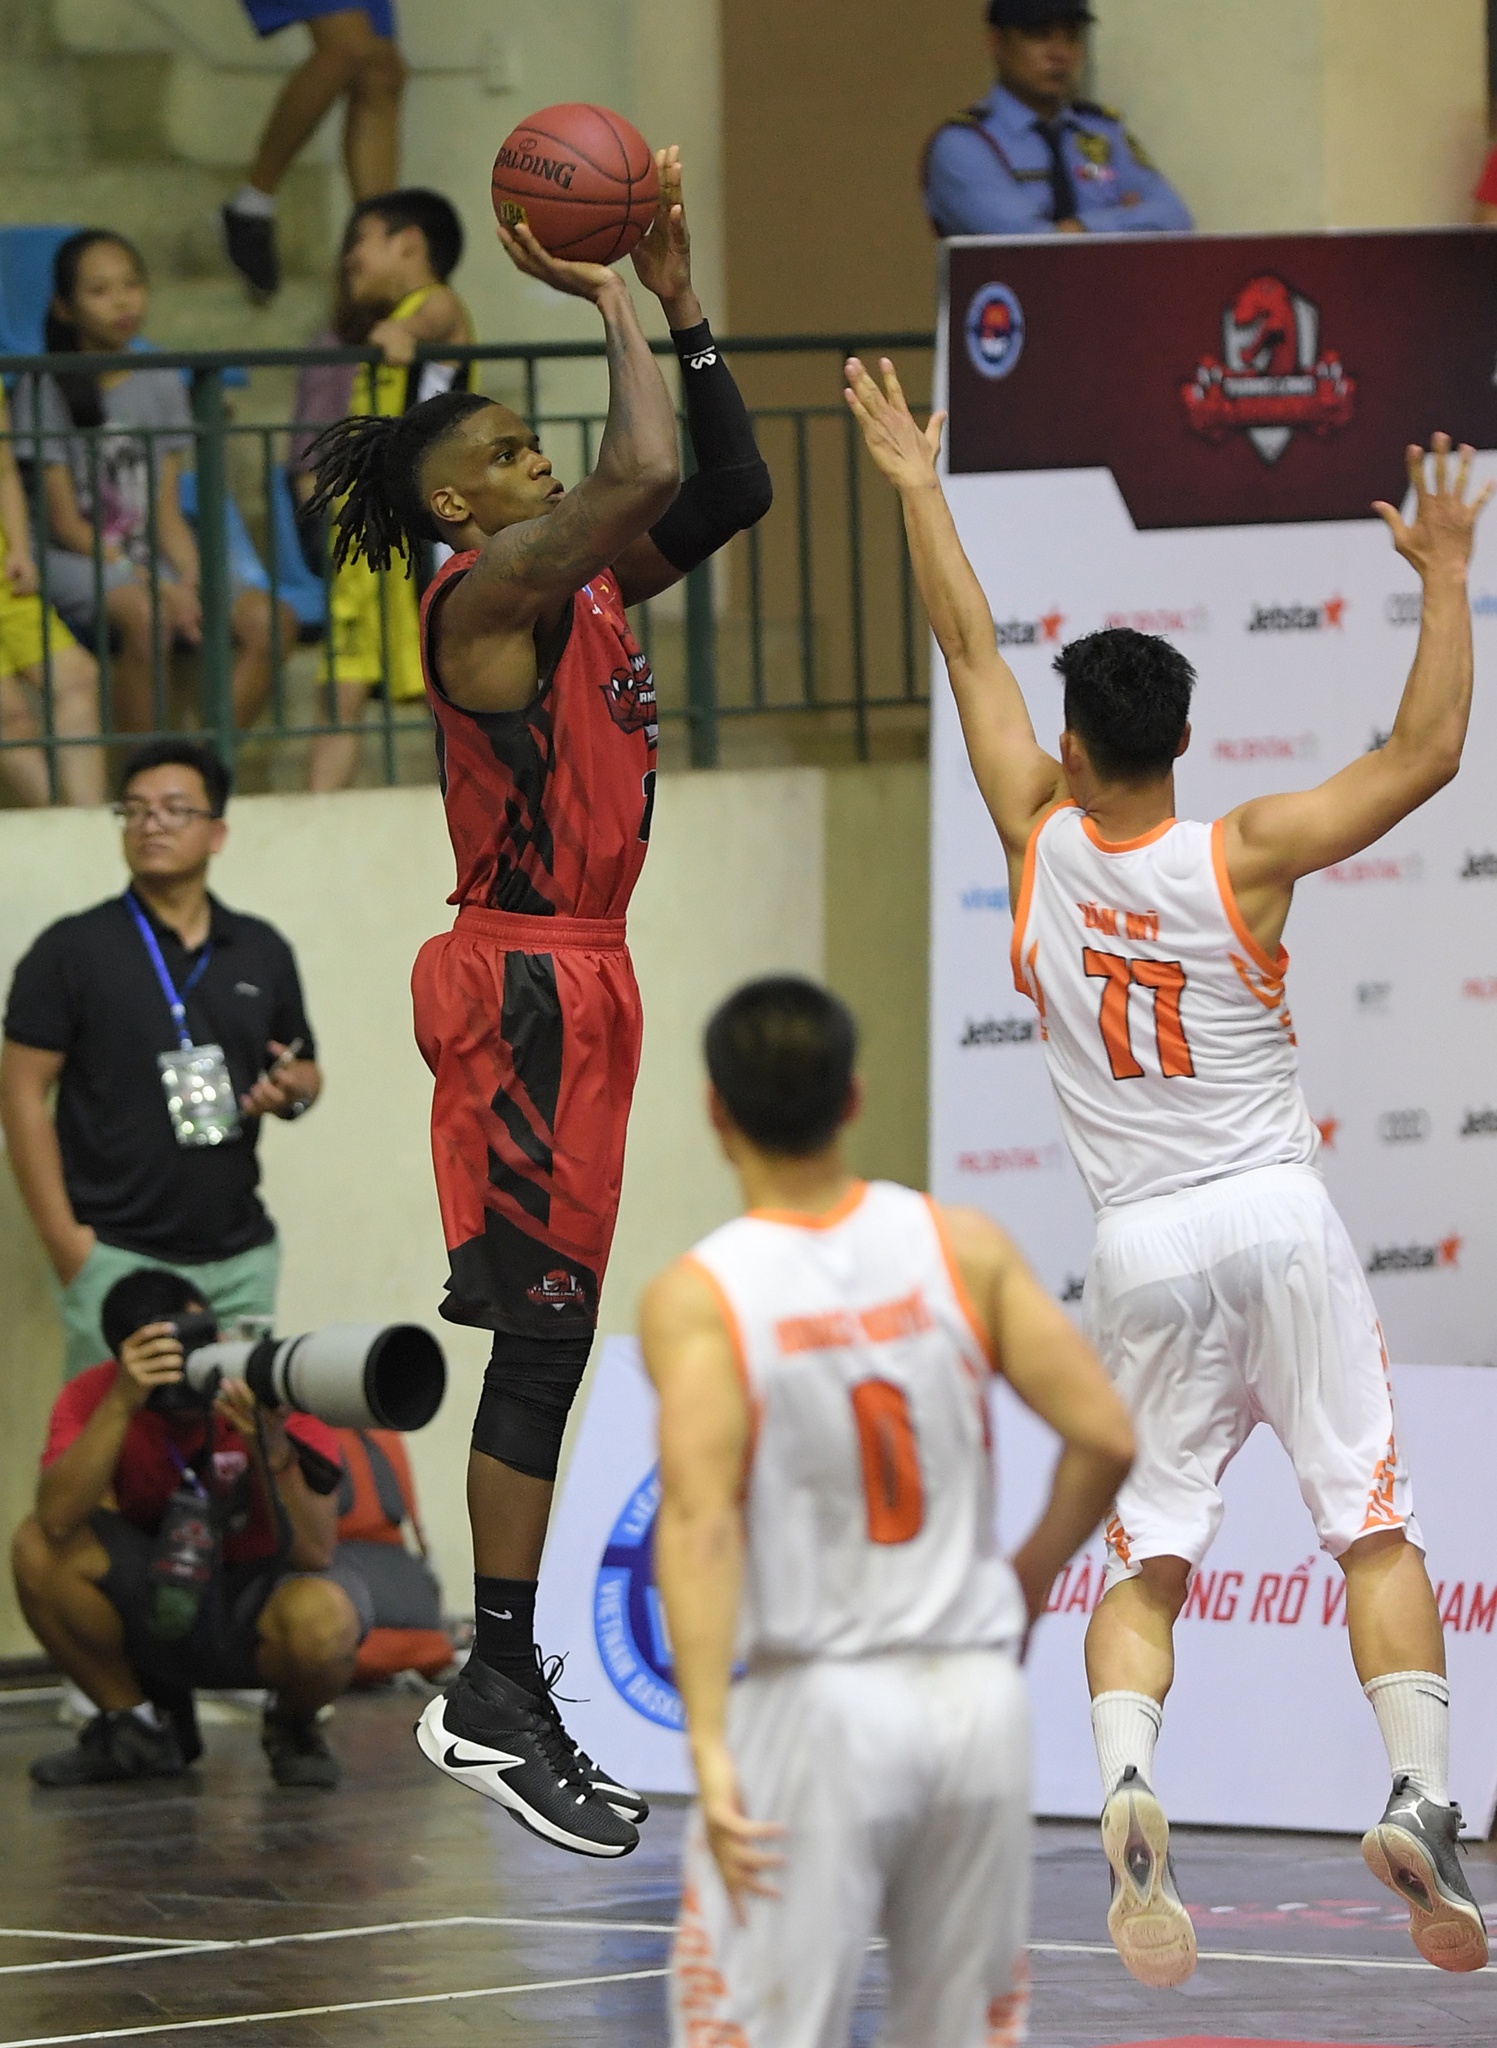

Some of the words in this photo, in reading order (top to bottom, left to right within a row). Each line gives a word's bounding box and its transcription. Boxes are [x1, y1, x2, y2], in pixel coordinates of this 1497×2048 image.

[493, 147, 577, 191] PALDING
[1248, 599, 1319, 632] Jetstar
[960, 1014, 1036, 1047] Jetstar
[1082, 946, 1196, 1080] 77
[1367, 1241, 1436, 1274] Jetstar
[849, 1379, 924, 1545] 0
[1184, 1570, 1243, 1621] NG
[624, 1672, 689, 1727] BASK
